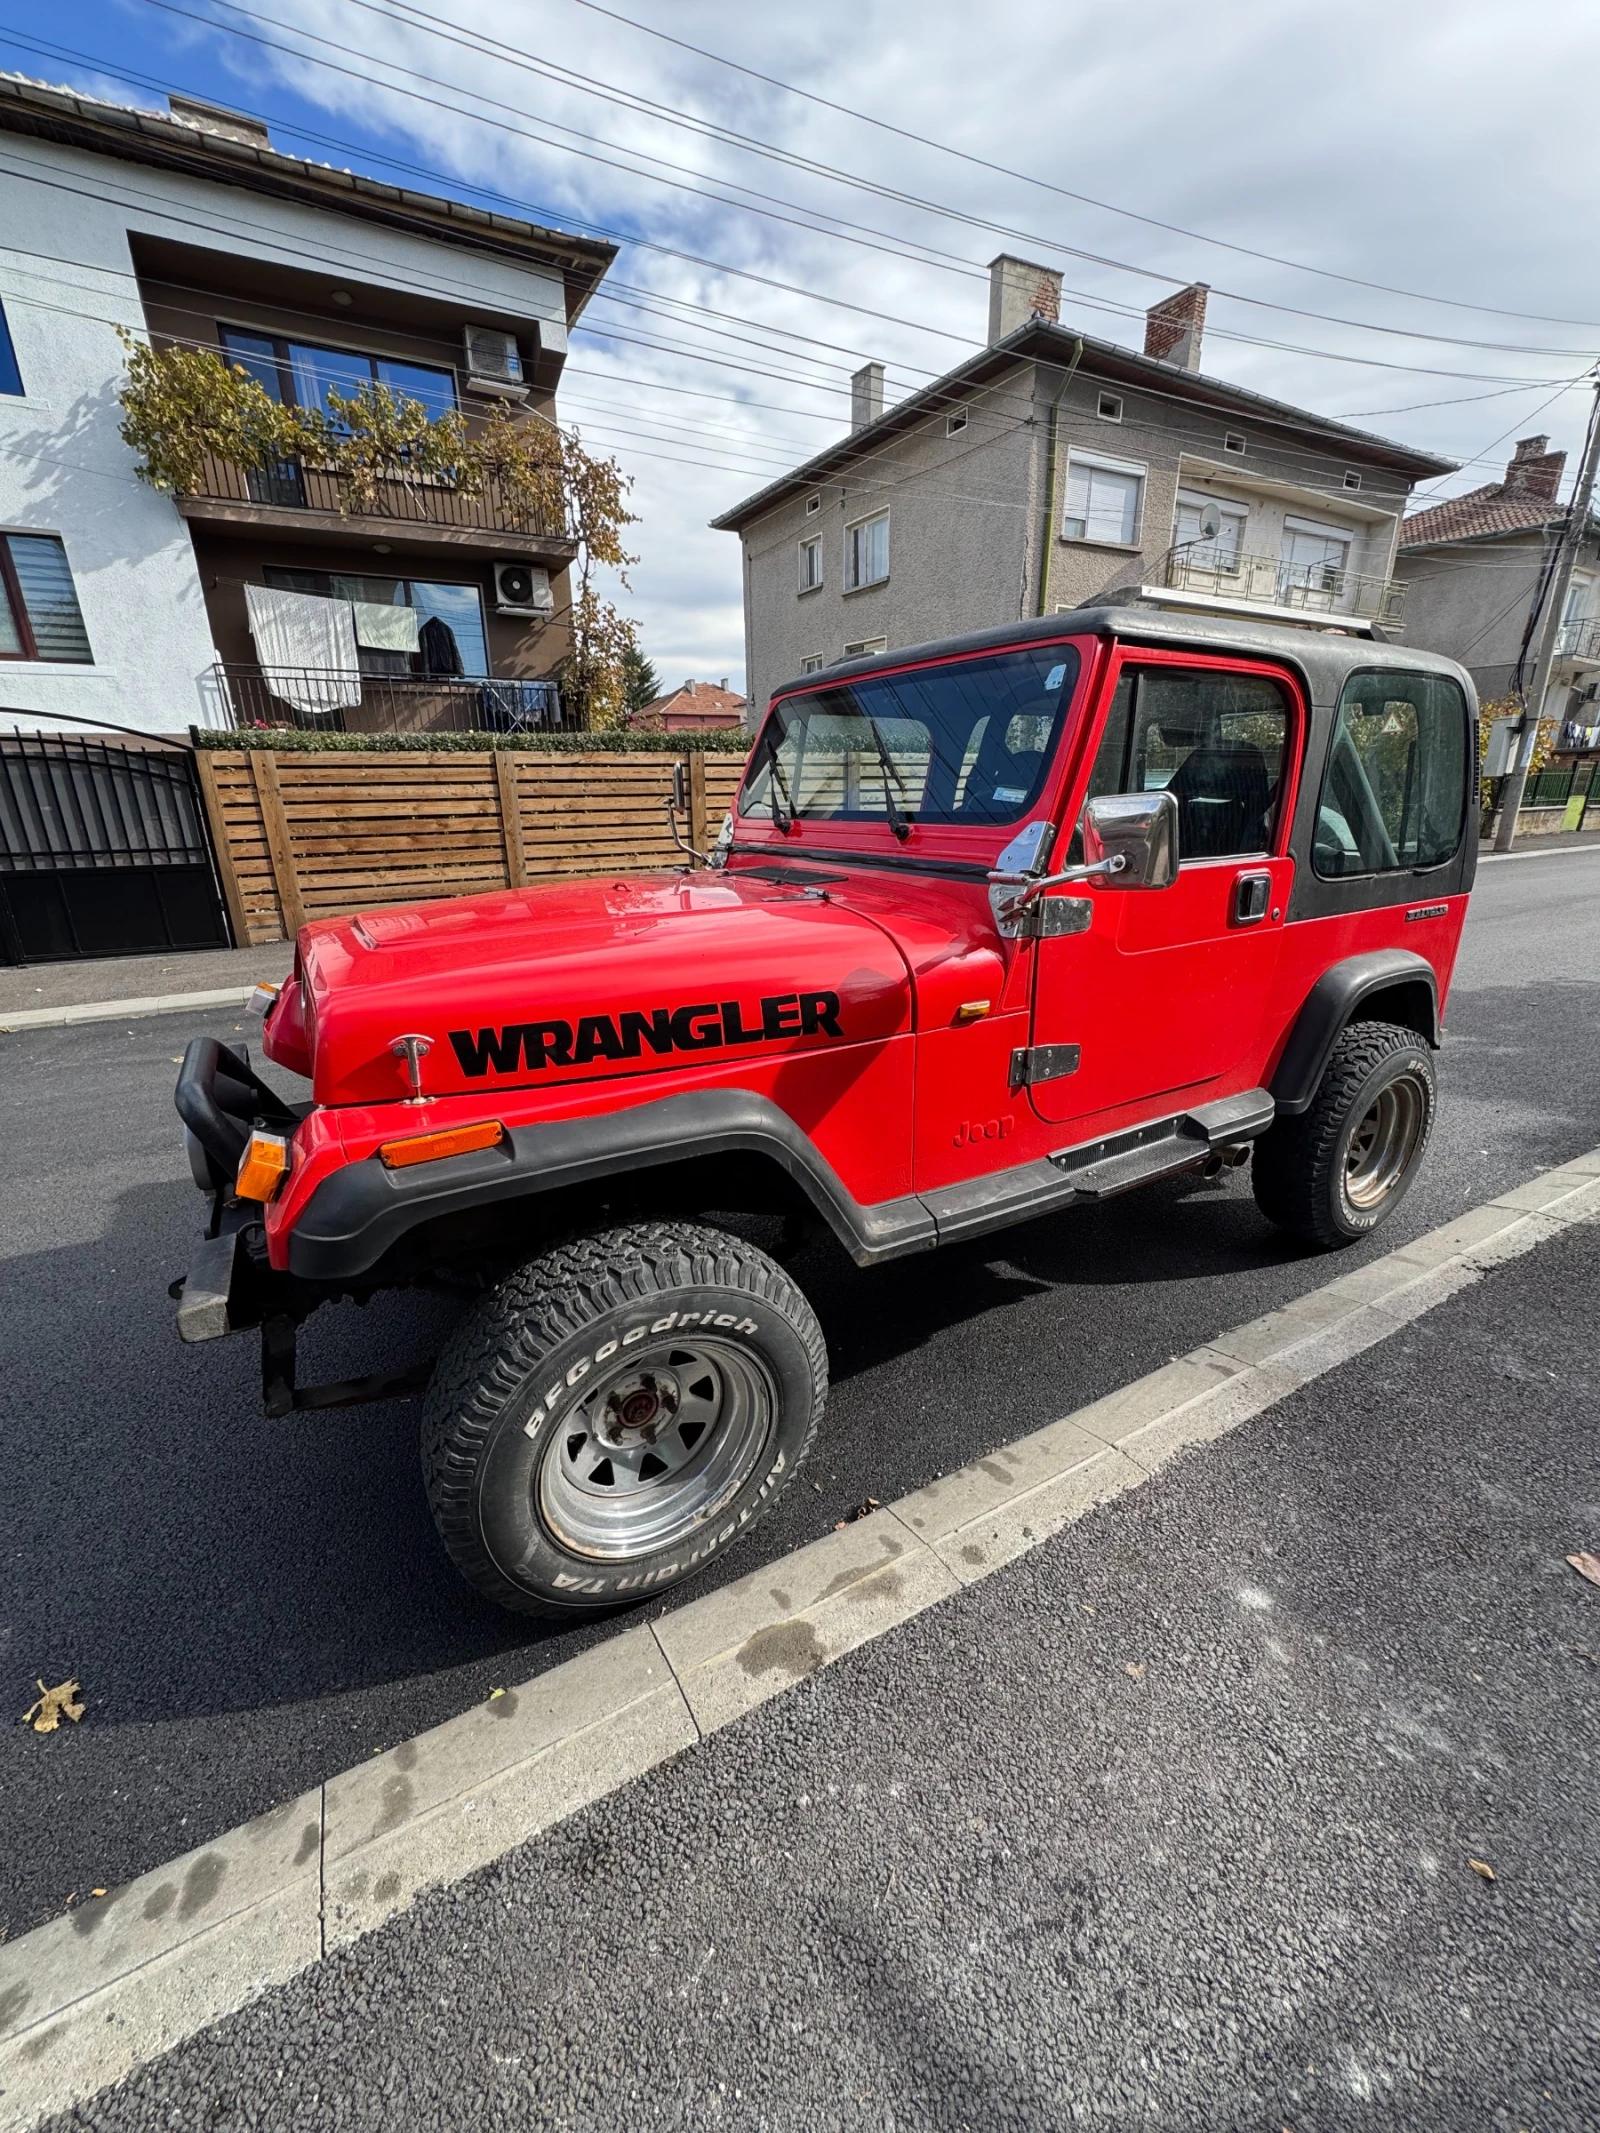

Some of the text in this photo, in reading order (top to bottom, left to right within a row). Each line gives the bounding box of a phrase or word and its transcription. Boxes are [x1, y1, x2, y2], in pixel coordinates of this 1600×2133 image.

[447, 990, 846, 1078] WRANGLER
[952, 1114, 1015, 1148] Jeep
[523, 1309, 759, 1440] BFGoodrich
[615, 1449, 786, 1591] All-Terrain
[551, 1572, 610, 1595] T/A
